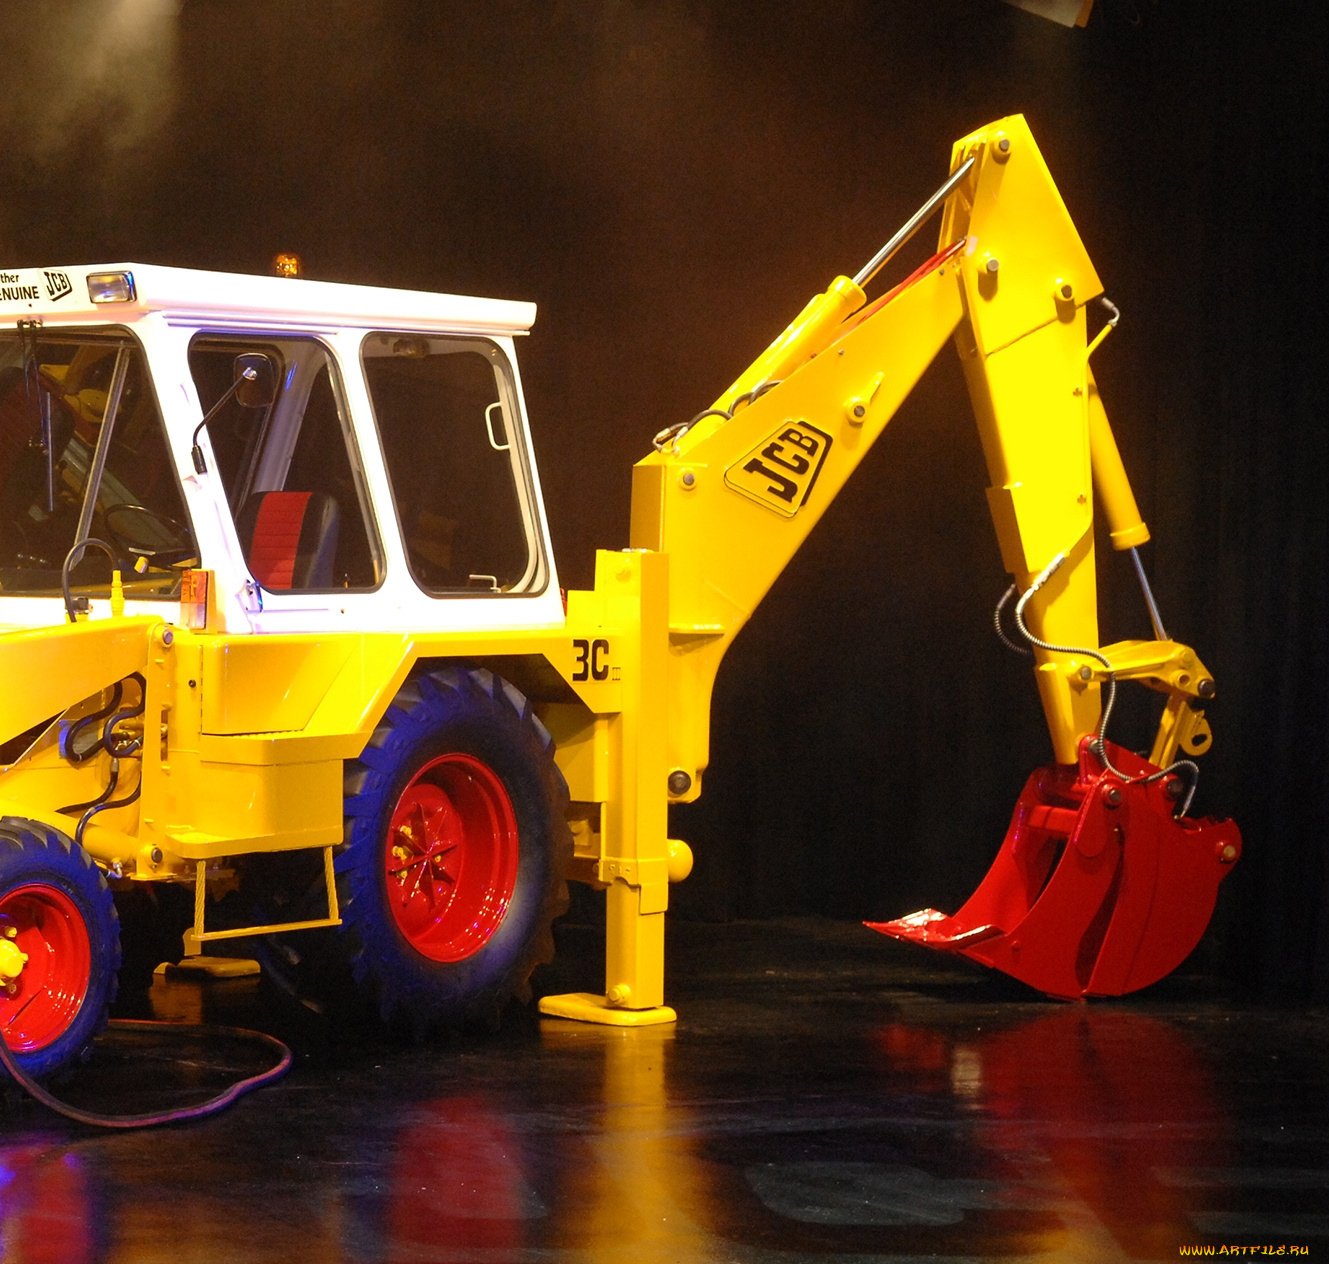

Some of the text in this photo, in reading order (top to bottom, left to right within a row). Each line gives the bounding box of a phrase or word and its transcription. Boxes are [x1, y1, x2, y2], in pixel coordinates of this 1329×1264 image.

[43, 271, 69, 297] JCB
[742, 428, 819, 504] JCB
[572, 639, 609, 682] 3C
